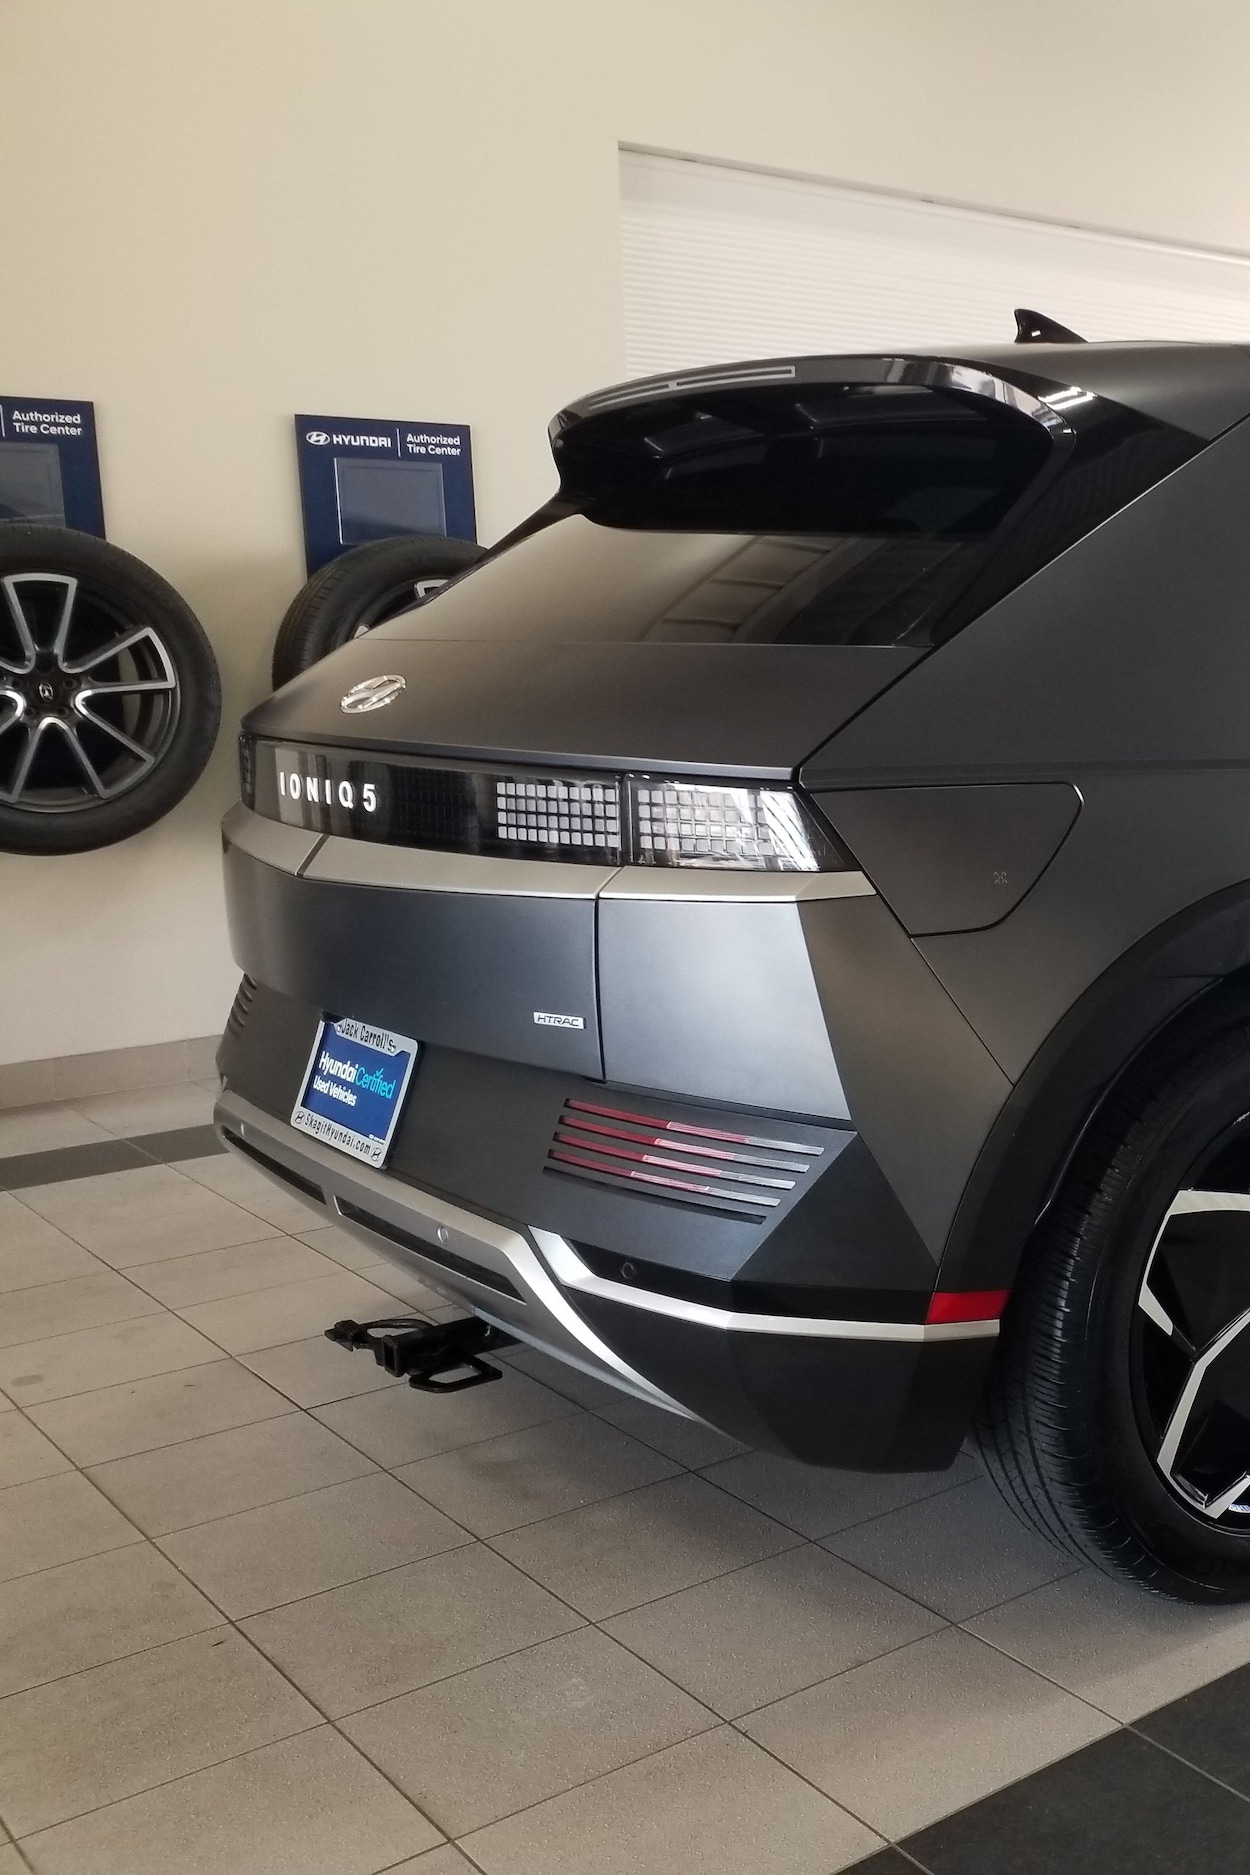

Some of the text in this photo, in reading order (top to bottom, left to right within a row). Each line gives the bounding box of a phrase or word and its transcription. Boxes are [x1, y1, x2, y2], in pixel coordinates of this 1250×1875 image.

[12, 410, 81, 424] Authorized
[13, 422, 82, 436] Tire Center
[332, 434, 392, 448] HYUNDAI
[406, 433, 460, 446] Authorized
[407, 443, 461, 456] Tire Center
[279, 771, 377, 813] IONIQ 5
[537, 1014, 580, 1027] HTRAC
[341, 1019, 359, 1039] Jack
[313, 1075, 358, 1107] Used Vehicles
[304, 1113, 371, 1155] SkagitHyundai.com
